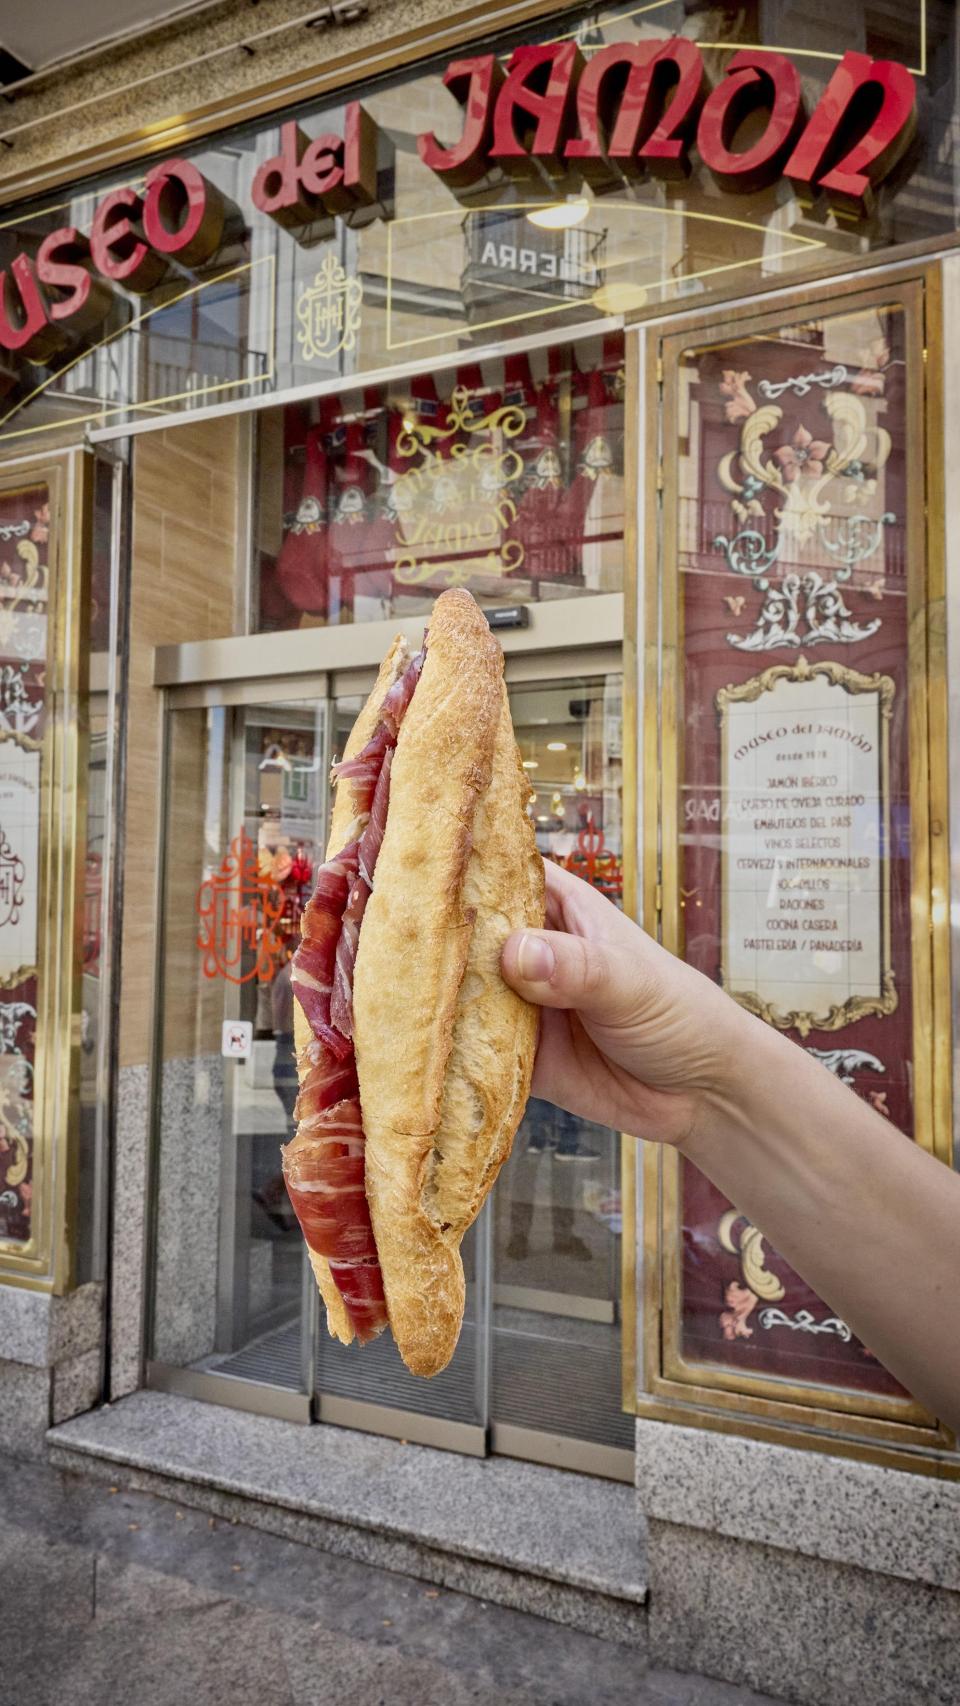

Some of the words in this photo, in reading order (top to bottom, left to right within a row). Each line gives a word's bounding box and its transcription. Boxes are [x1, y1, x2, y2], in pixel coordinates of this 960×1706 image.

[252, 101, 360, 213] del
[417, 37, 917, 197] JAMON
[792, 723, 813, 735] del
[776, 752, 803, 761] desde
[768, 775, 798, 788] JAMÓN
[741, 798, 774, 811] QUESO
[776, 797, 788, 809] DE
[792, 796, 822, 809] OVEJA
[825, 795, 865, 808] CURADO
[754, 817, 807, 830] EMBUTIDOS
[810, 817, 827, 829] DEL
[764, 838, 793, 849] VINOS
[795, 837, 841, 849] SELECTOS
[785, 856, 871, 869] INTERNACIONALES
[779, 899, 825, 911] RACIONES
[766, 919, 798, 931] COCINA
[802, 919, 838, 931] CASERA
